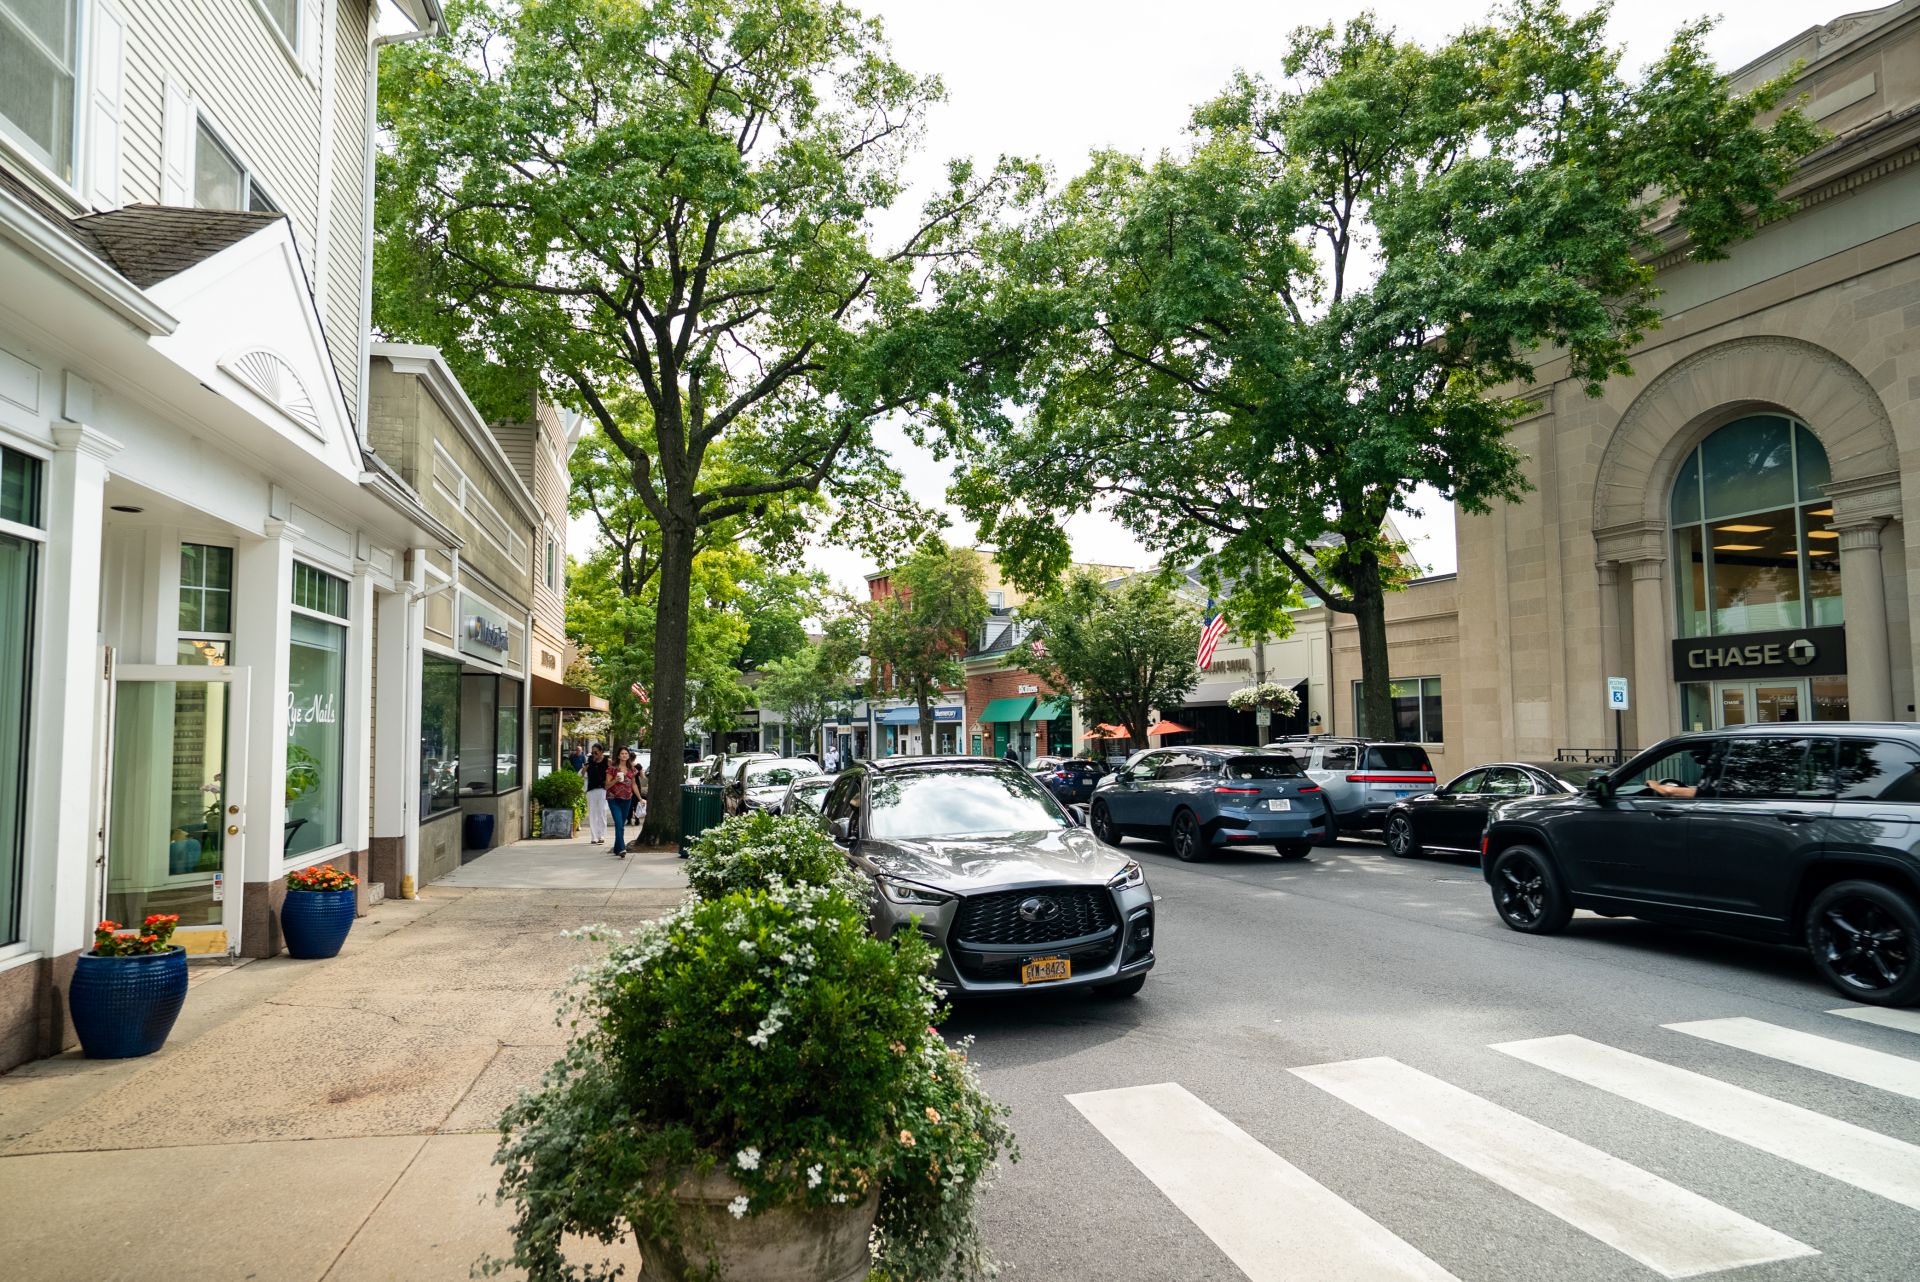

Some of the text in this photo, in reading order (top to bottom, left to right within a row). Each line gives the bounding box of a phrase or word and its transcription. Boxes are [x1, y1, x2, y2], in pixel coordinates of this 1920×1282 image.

[1688, 644, 1784, 669] CHASE
[288, 691, 336, 737] Rye Nails
